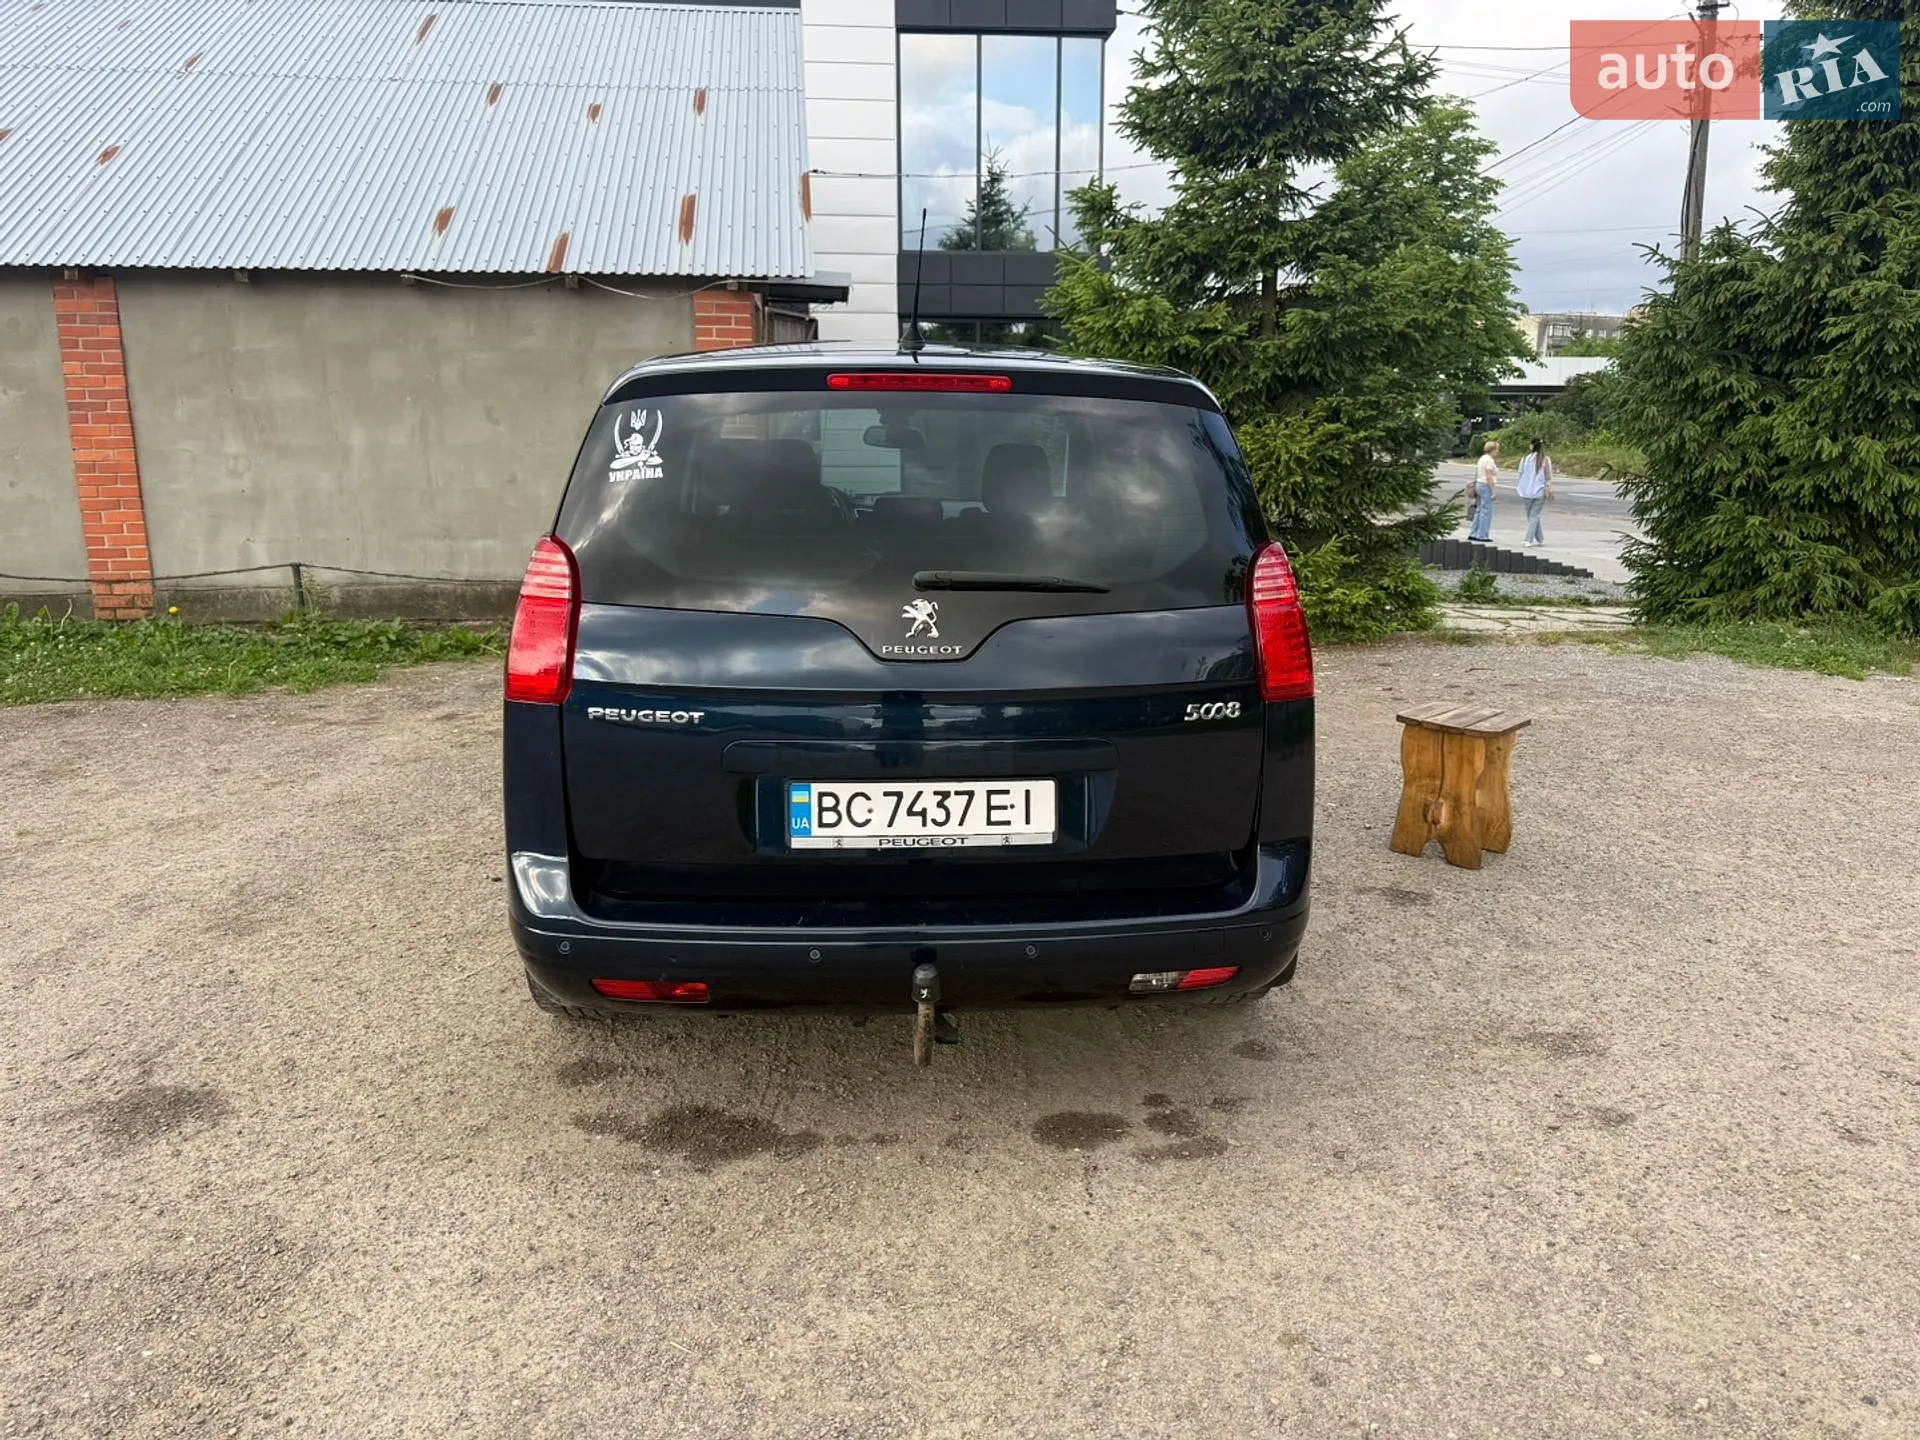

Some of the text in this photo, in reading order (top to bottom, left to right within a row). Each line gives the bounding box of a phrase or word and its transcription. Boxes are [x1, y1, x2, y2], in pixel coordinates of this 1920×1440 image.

[608, 466, 664, 483] УКРАЇНА
[882, 645, 962, 654] PEUGEOT
[587, 706, 705, 724] PEUGEOT
[1184, 701, 1241, 721] 5008
[792, 816, 810, 830] UA
[878, 837, 969, 848] PEUGEOT
